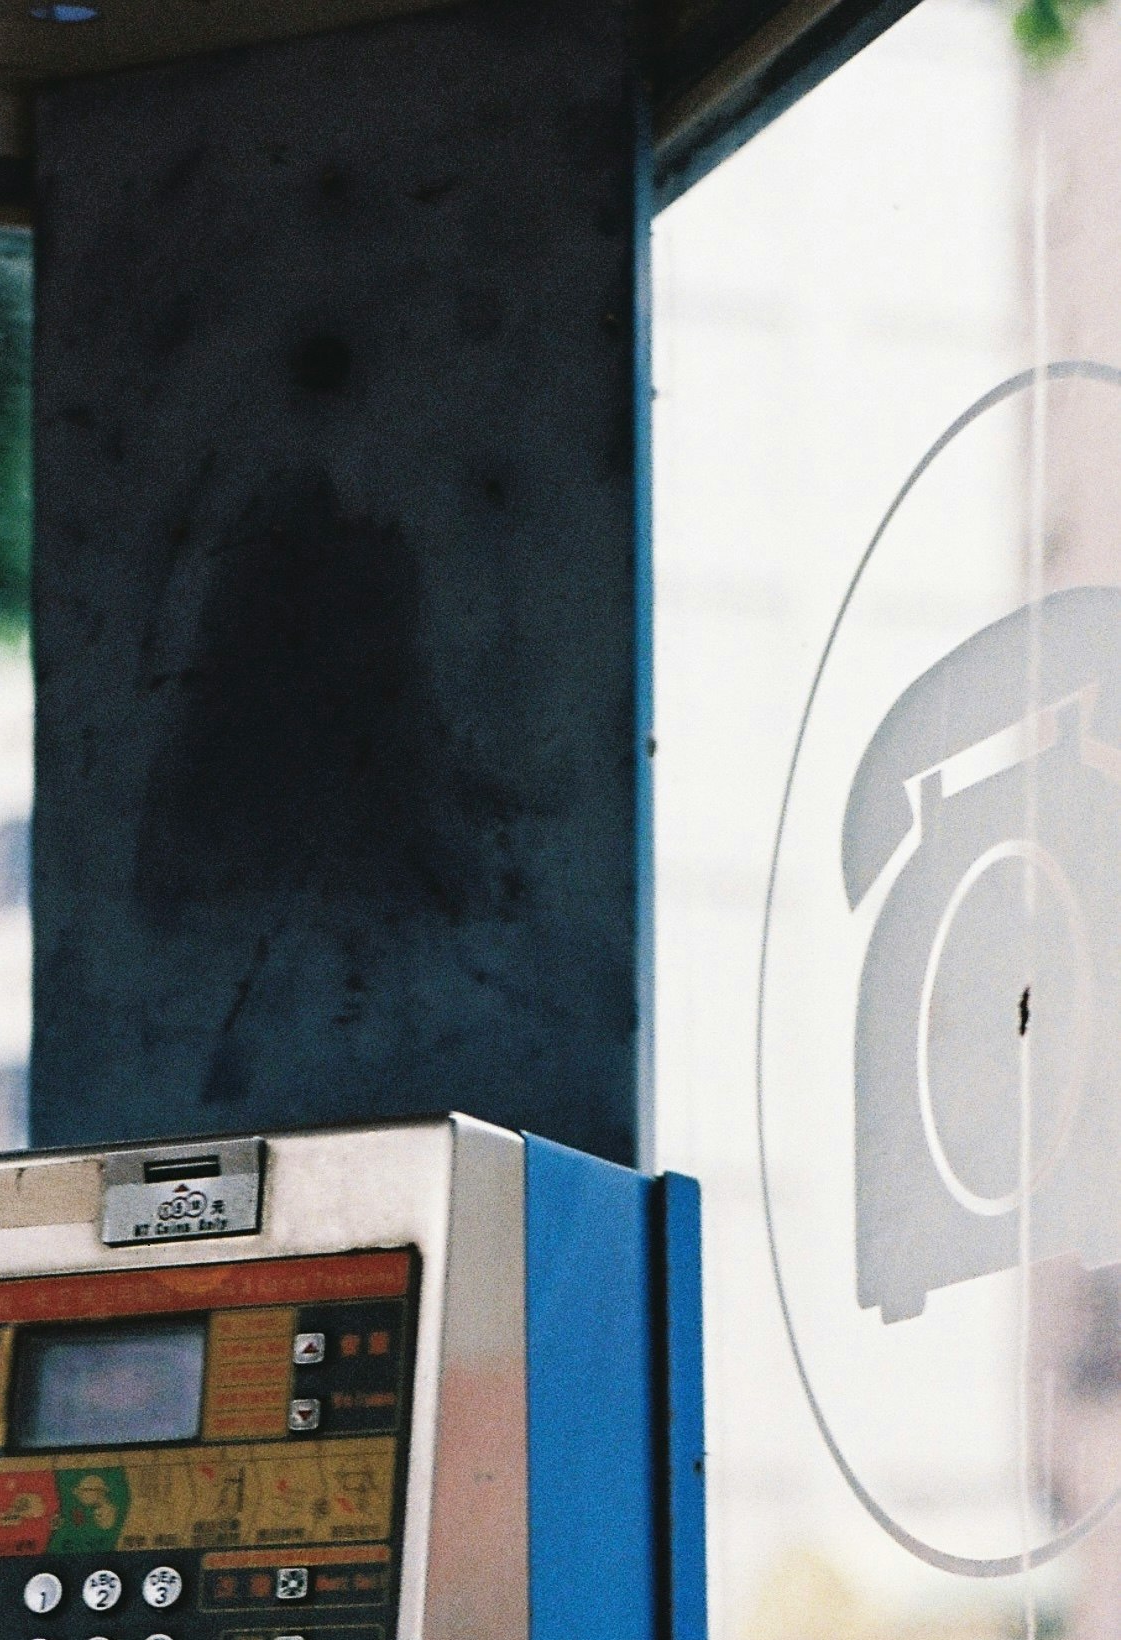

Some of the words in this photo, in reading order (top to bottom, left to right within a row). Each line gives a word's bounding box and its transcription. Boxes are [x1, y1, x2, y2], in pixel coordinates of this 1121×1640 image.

[212, 1200, 224, 1214] 元
[91, 1573, 118, 1588] ABC
[149, 1570, 178, 1586] DEF
[97, 1590, 109, 1607] 2
[155, 1587, 167, 1604] 3
